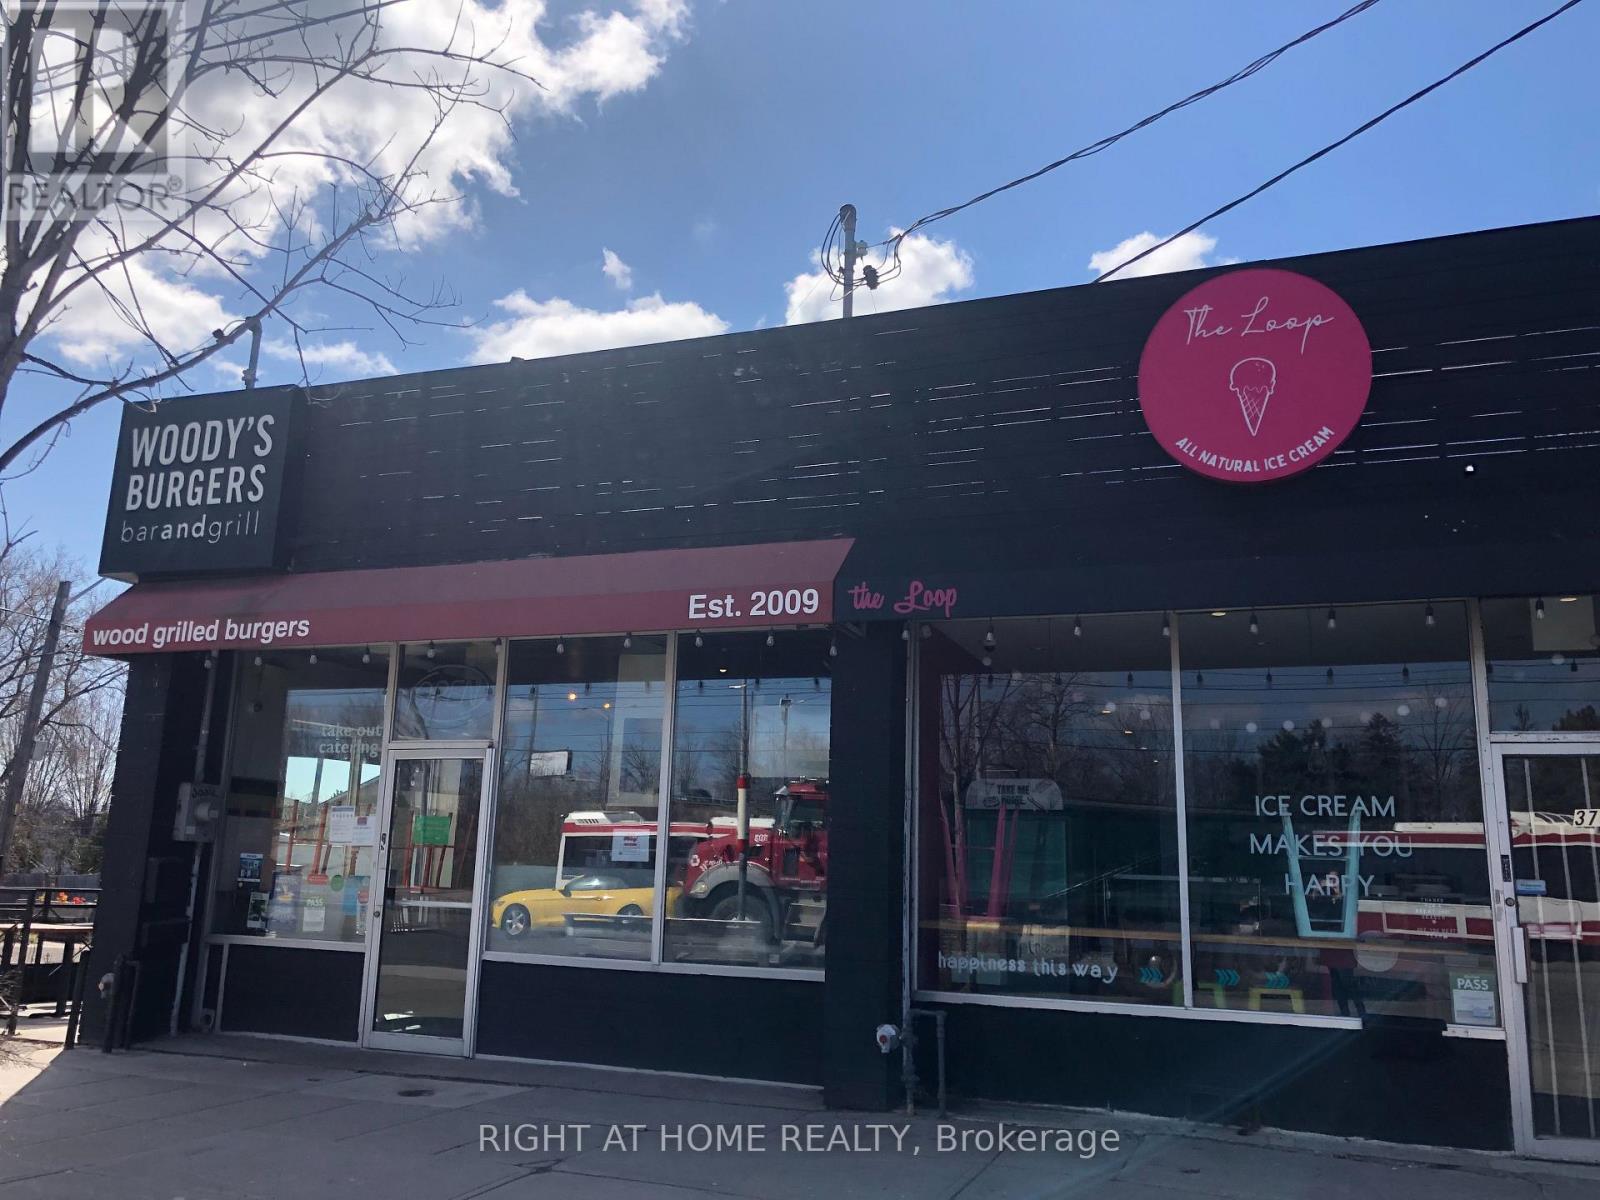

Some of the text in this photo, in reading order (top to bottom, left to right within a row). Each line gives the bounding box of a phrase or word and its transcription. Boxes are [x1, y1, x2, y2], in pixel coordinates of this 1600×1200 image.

[1184, 296, 1335, 355] The Loop
[131, 414, 275, 468] WOODY'S
[1175, 426, 1335, 473] ALL NATURAL ICE CREAM
[125, 463, 267, 512] BURGERS
[688, 588, 819, 619] Est. 2009
[847, 580, 958, 618] the Loop
[92, 616, 311, 649] wood grilled burgers
[356, 724, 383, 737] out
[319, 741, 379, 758] catering
[1255, 795, 1396, 817] ICE CREAM
[1574, 810, 1598, 826] 37
[1250, 833, 1413, 858] MAKES YOU
[1285, 873, 1383, 898] HAPPY.
[938, 950, 1118, 984] happiness this way
[1456, 977, 1489, 991] PASS
